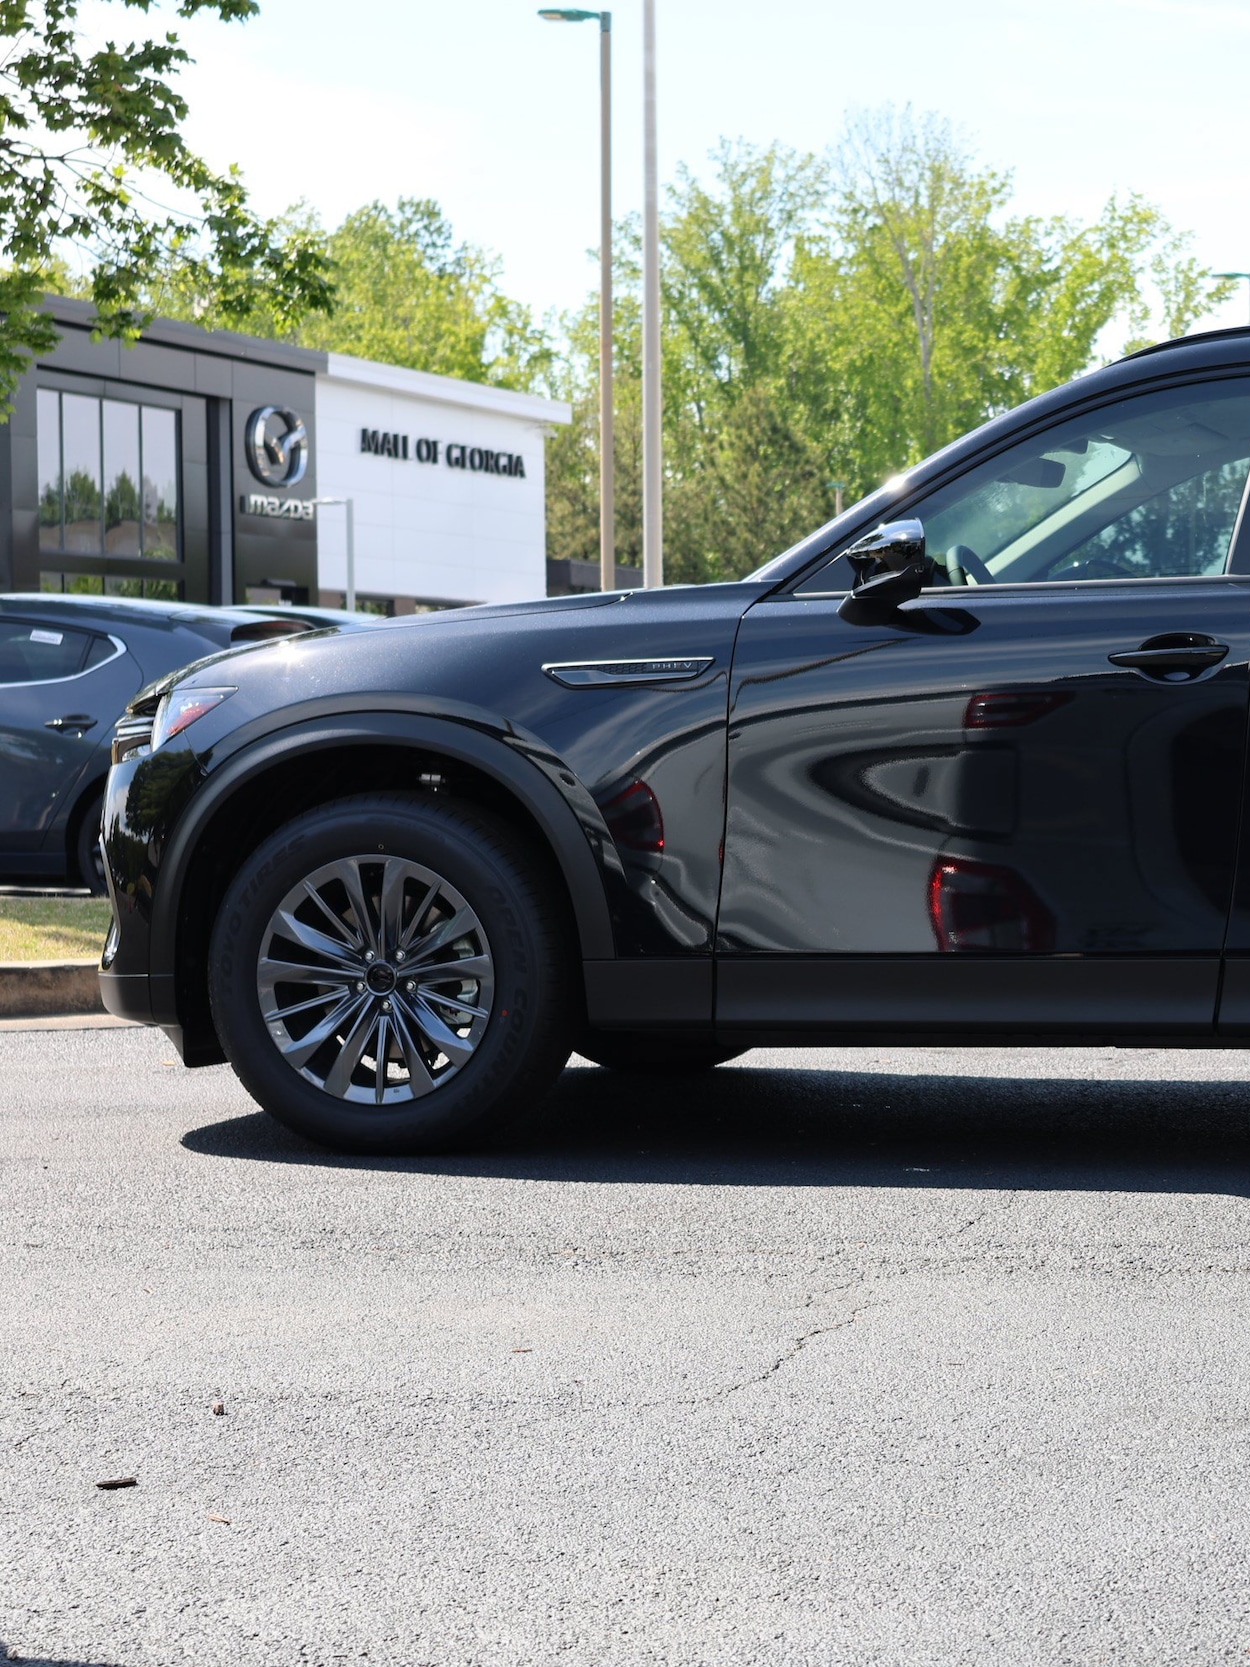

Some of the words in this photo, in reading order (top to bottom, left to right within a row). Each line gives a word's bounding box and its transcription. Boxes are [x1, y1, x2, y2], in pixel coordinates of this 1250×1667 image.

[361, 428, 412, 460] MALL
[416, 438, 441, 465] OF
[446, 443, 526, 478] GEORGIA
[249, 493, 314, 520] mazda
